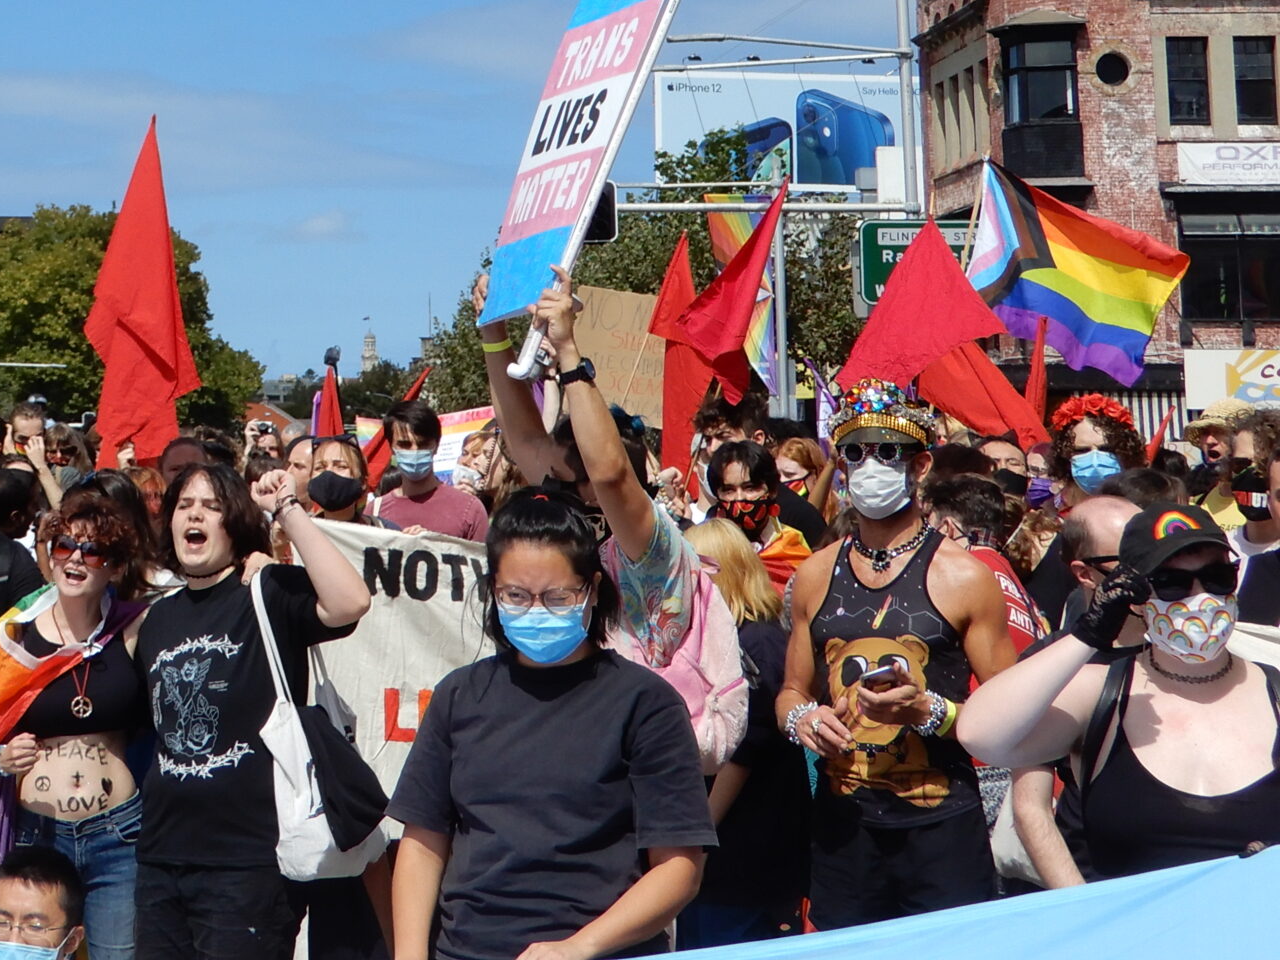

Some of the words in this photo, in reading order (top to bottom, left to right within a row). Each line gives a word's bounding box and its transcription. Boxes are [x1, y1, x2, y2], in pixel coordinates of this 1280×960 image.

[556, 17, 639, 89] TRANS
[675, 83, 710, 93] iPhone
[712, 84, 722, 93] 12
[862, 87, 877, 96] Say
[531, 88, 608, 157] LIVES
[1202, 163, 1280, 171] PERFORM
[508, 157, 592, 225] MATTER
[44, 741, 108, 765] PEACE
[57, 793, 108, 813] LOVE
